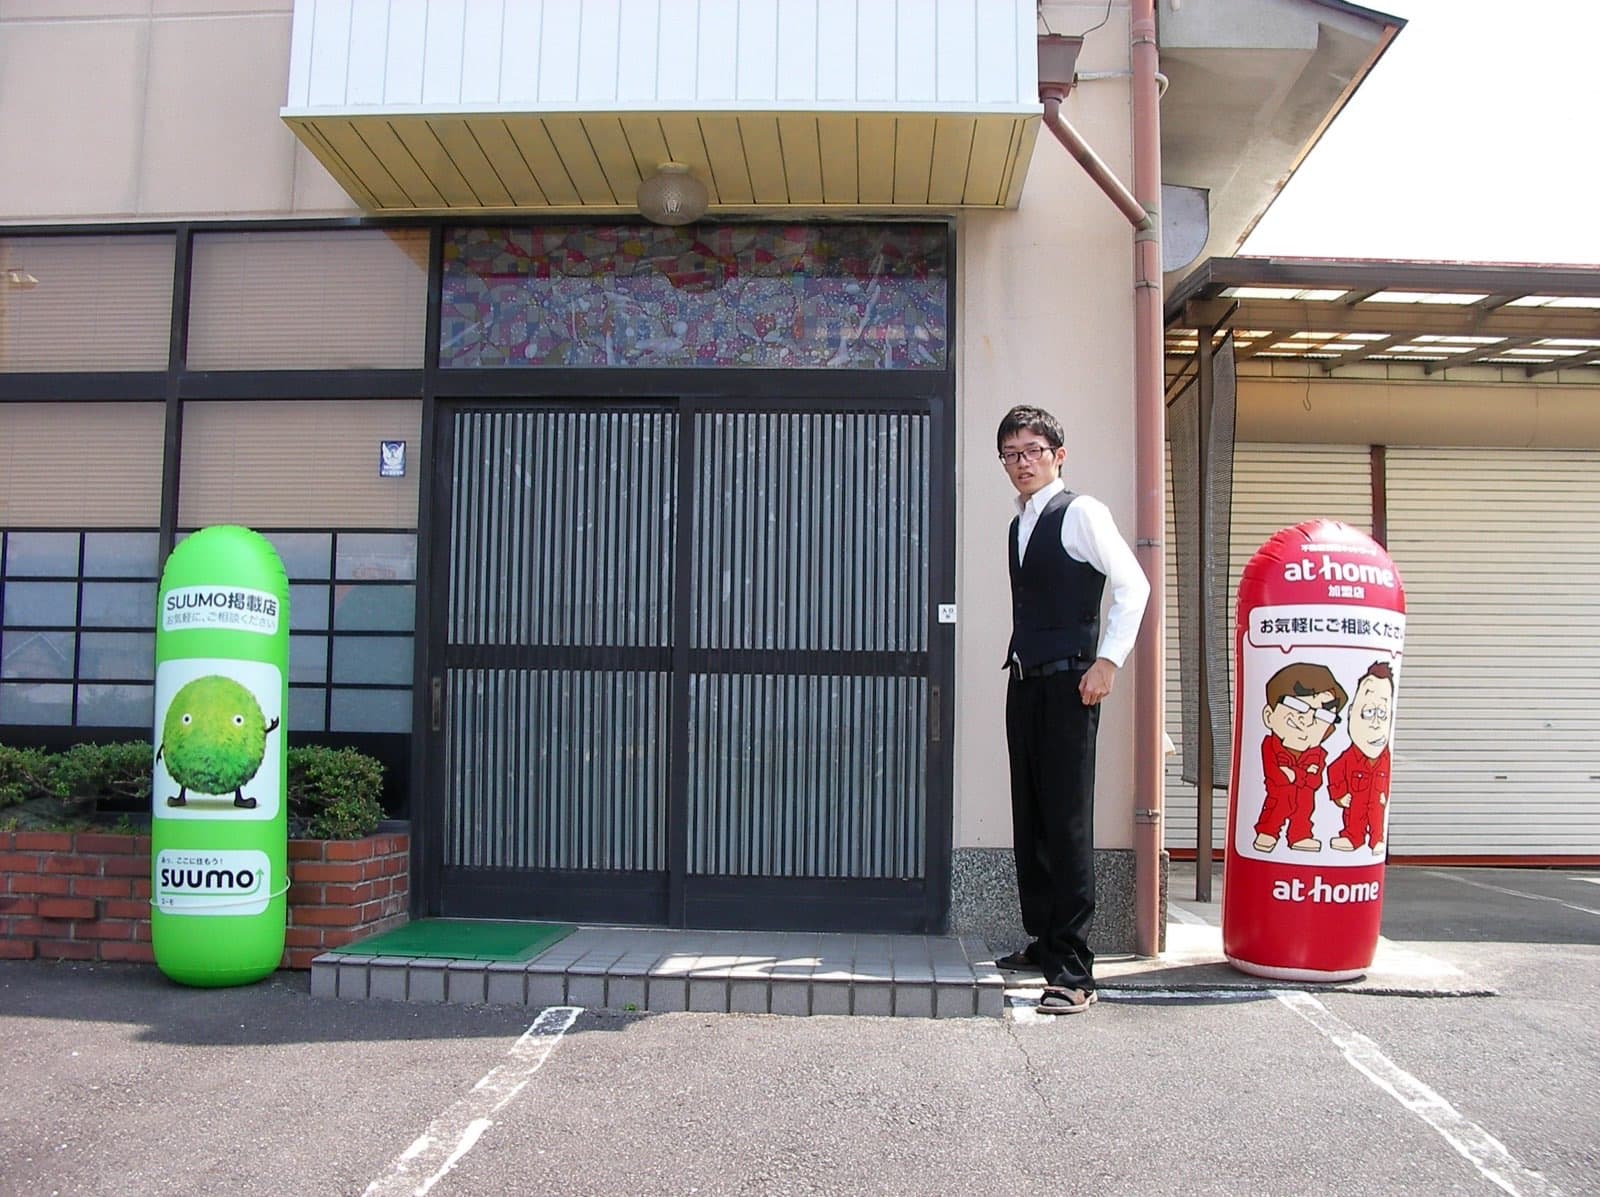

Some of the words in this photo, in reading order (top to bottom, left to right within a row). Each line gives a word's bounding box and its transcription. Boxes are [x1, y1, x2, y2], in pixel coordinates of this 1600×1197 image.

[1284, 559, 1316, 581] at
[1319, 555, 1395, 588] home
[167, 592, 277, 616] SUUMO掲載店
[1272, 878, 1305, 901] at
[1308, 876, 1379, 903] home
